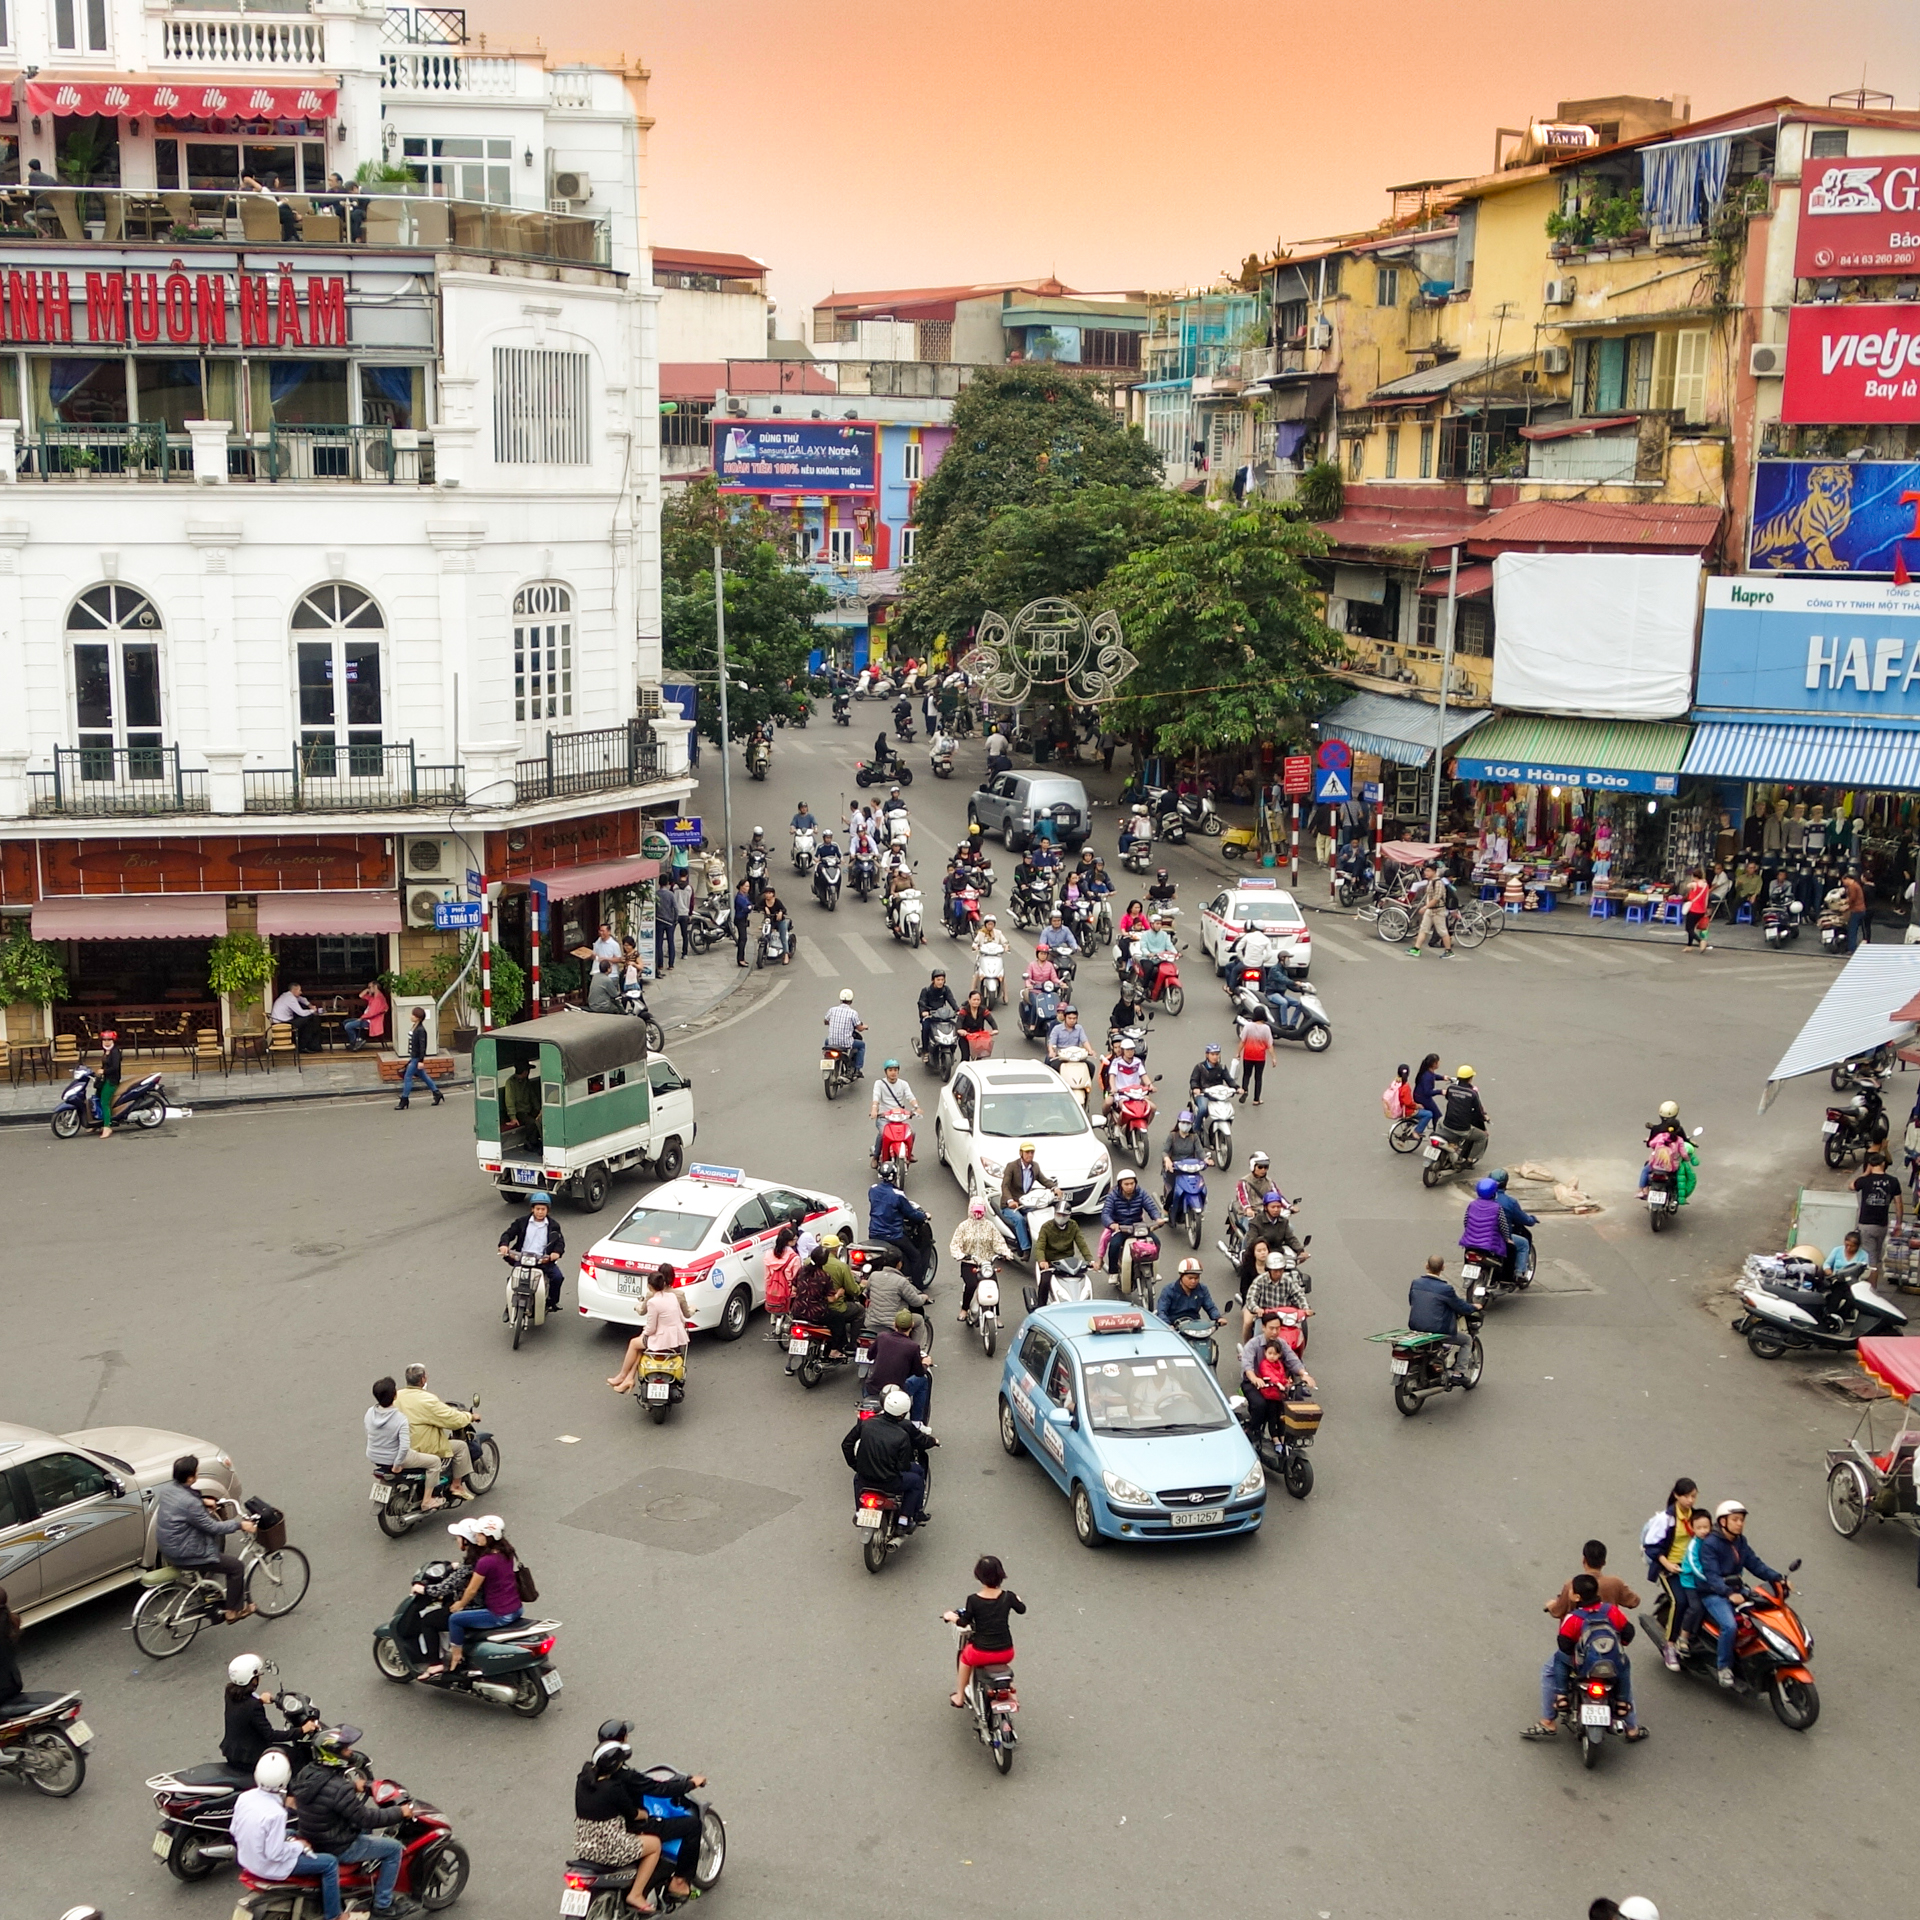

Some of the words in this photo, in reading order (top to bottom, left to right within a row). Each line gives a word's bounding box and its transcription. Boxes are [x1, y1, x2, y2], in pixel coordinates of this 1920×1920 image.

[56, 86, 81, 109] illy
[104, 86, 130, 109] illy
[154, 87, 179, 110] illy
[202, 88, 227, 110] illy
[250, 89, 274, 110] illy
[297, 90, 322, 111] illy
[1840, 255, 1852, 266] 84
[1861, 254, 1873, 265] 63
[1875, 254, 1893, 264] 260
[1894, 253, 1912, 264] 260
[0, 270, 72, 341] NH
[85, 258, 227, 343] MUÔN
[239, 261, 346, 347] NĂM
[1865, 380, 1899, 401] Bay
[1901, 378, 1918, 397] là
[759, 432, 782, 444] DÙNG
[759, 446, 787, 456] Samsung
[788, 444, 827, 456] GALAXY
[774, 462, 800, 475] 100%
[816, 465, 840, 476] KHÔNG
[840, 466, 861, 476] THÍCH
[1731, 584, 1774, 607] Hapro
[1806, 598, 1833, 609] CÔNG
[1835, 600, 1847, 609] TY
[1850, 600, 1875, 609] TNHH
[1878, 600, 1899, 612] MỘT
[1484, 765, 1521, 779] 104
[1528, 767, 1581, 785] Hàng
[1586, 772, 1629, 787] Đào
[124, 853, 159, 868] Bar
[439, 913, 449, 924] LÊ
[450, 912, 467, 924] THÁI
[601, 1258, 615, 1266] JAC
[624, 1275, 636, 1284] 30A
[1175, 1511, 1218, 1525] 30T-1257
